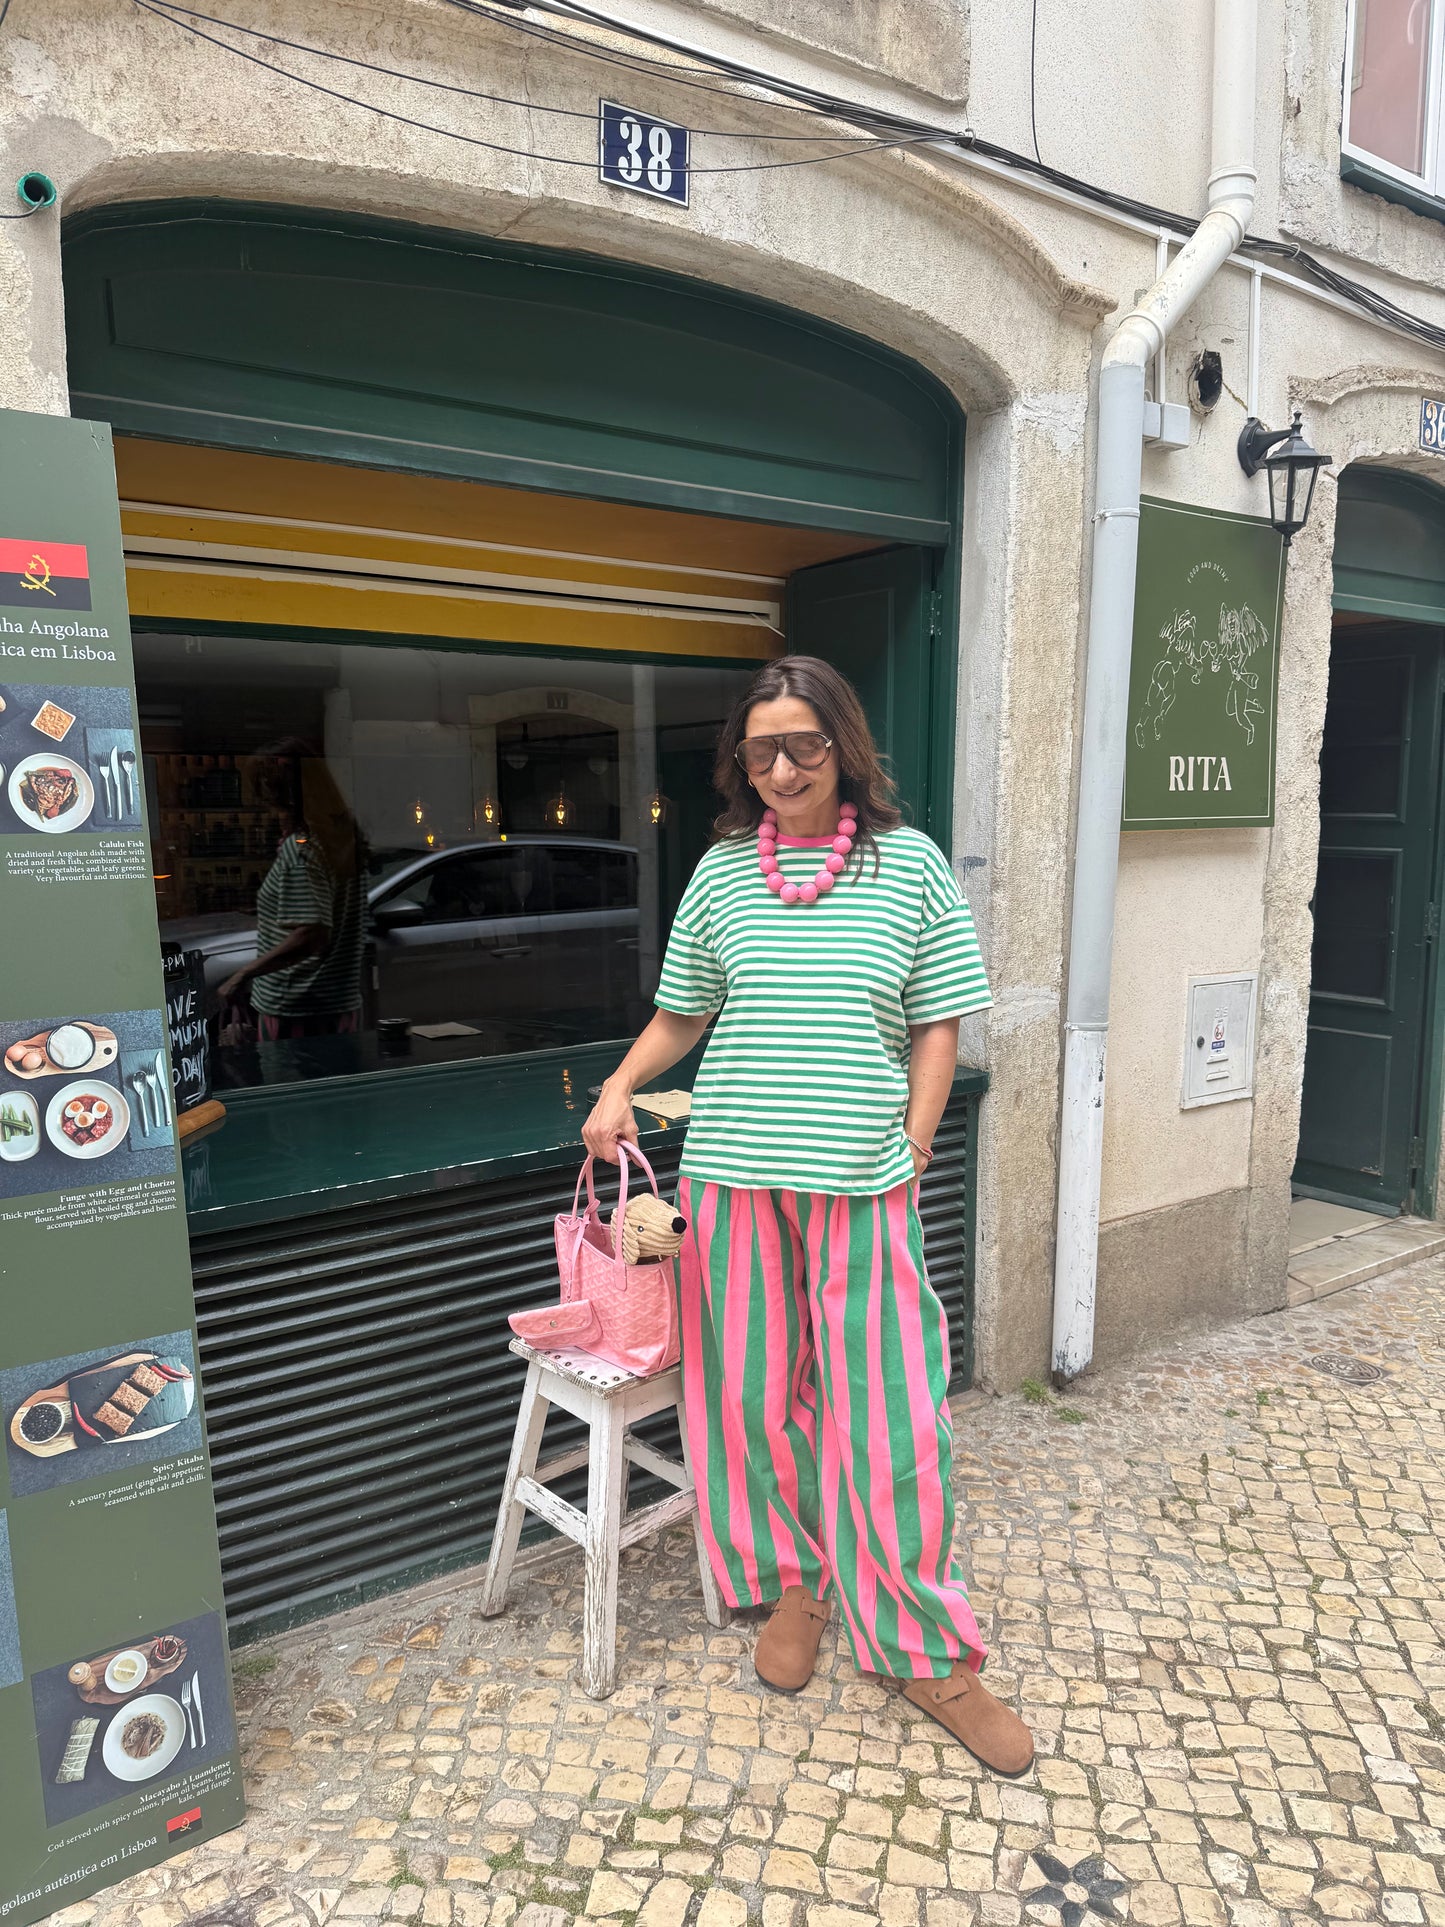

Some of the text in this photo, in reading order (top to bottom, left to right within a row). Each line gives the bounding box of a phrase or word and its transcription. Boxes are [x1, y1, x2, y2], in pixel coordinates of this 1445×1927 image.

[618, 116, 672, 192] 38
[0, 617, 109, 640] ha Angolana
[0, 642, 116, 661] ica em Lisboa
[1169, 755, 1232, 791] RITA
[14, 850, 54, 858] traditional
[57, 850, 88, 859] Angolan
[90, 849, 105, 857] dish
[129, 848, 145, 856] with
[99, 840, 144, 848] Calulu Fish
[8, 859, 28, 867] dried
[47, 858, 66, 866] fresh
[86, 857, 121, 865] combined
[8, 867, 35, 876] variety
[47, 866, 84, 876] vegetables
[86, 865, 100, 873] and
[102, 865, 119, 874] leafy
[35, 872, 148, 884] Very flavourful and nutritious.
[168, 990, 197, 1024] IVE
[1, 1212, 22, 1221] Thick
[24, 1207, 45, 1219] purée
[46, 1205, 67, 1214] made
[68, 1202, 86, 1211] from
[87, 1198, 107, 1207] white
[108, 1193, 141, 1204] cornmeal
[151, 1187, 176, 1197] cassava
[60, 1179, 175, 1203] Funge with Egg and Chorizo
[35, 1195, 177, 1224] flour, served with boiled egg and chorizo,
[46, 1203, 177, 1230] accompanied by vegetables and beans.
[153, 1455, 204, 1474] Spicy Kitaba
[77, 1491, 107, 1505] savoury
[108, 1484, 133, 1498] peanut
[135, 1473, 170, 1490] (ginguba)
[104, 1474, 206, 1507] seasoned with salt and chilli.
[139, 1783, 181, 1805] Macayabo
[189, 1760, 231, 1783] Luandense
[178, 1777, 232, 1805] kale, and funge.
[47, 1767, 232, 1853] Cod served with spicy onions, palm oil beans, fried
[0, 1836, 158, 1916] golana autêntica em Lisboa
